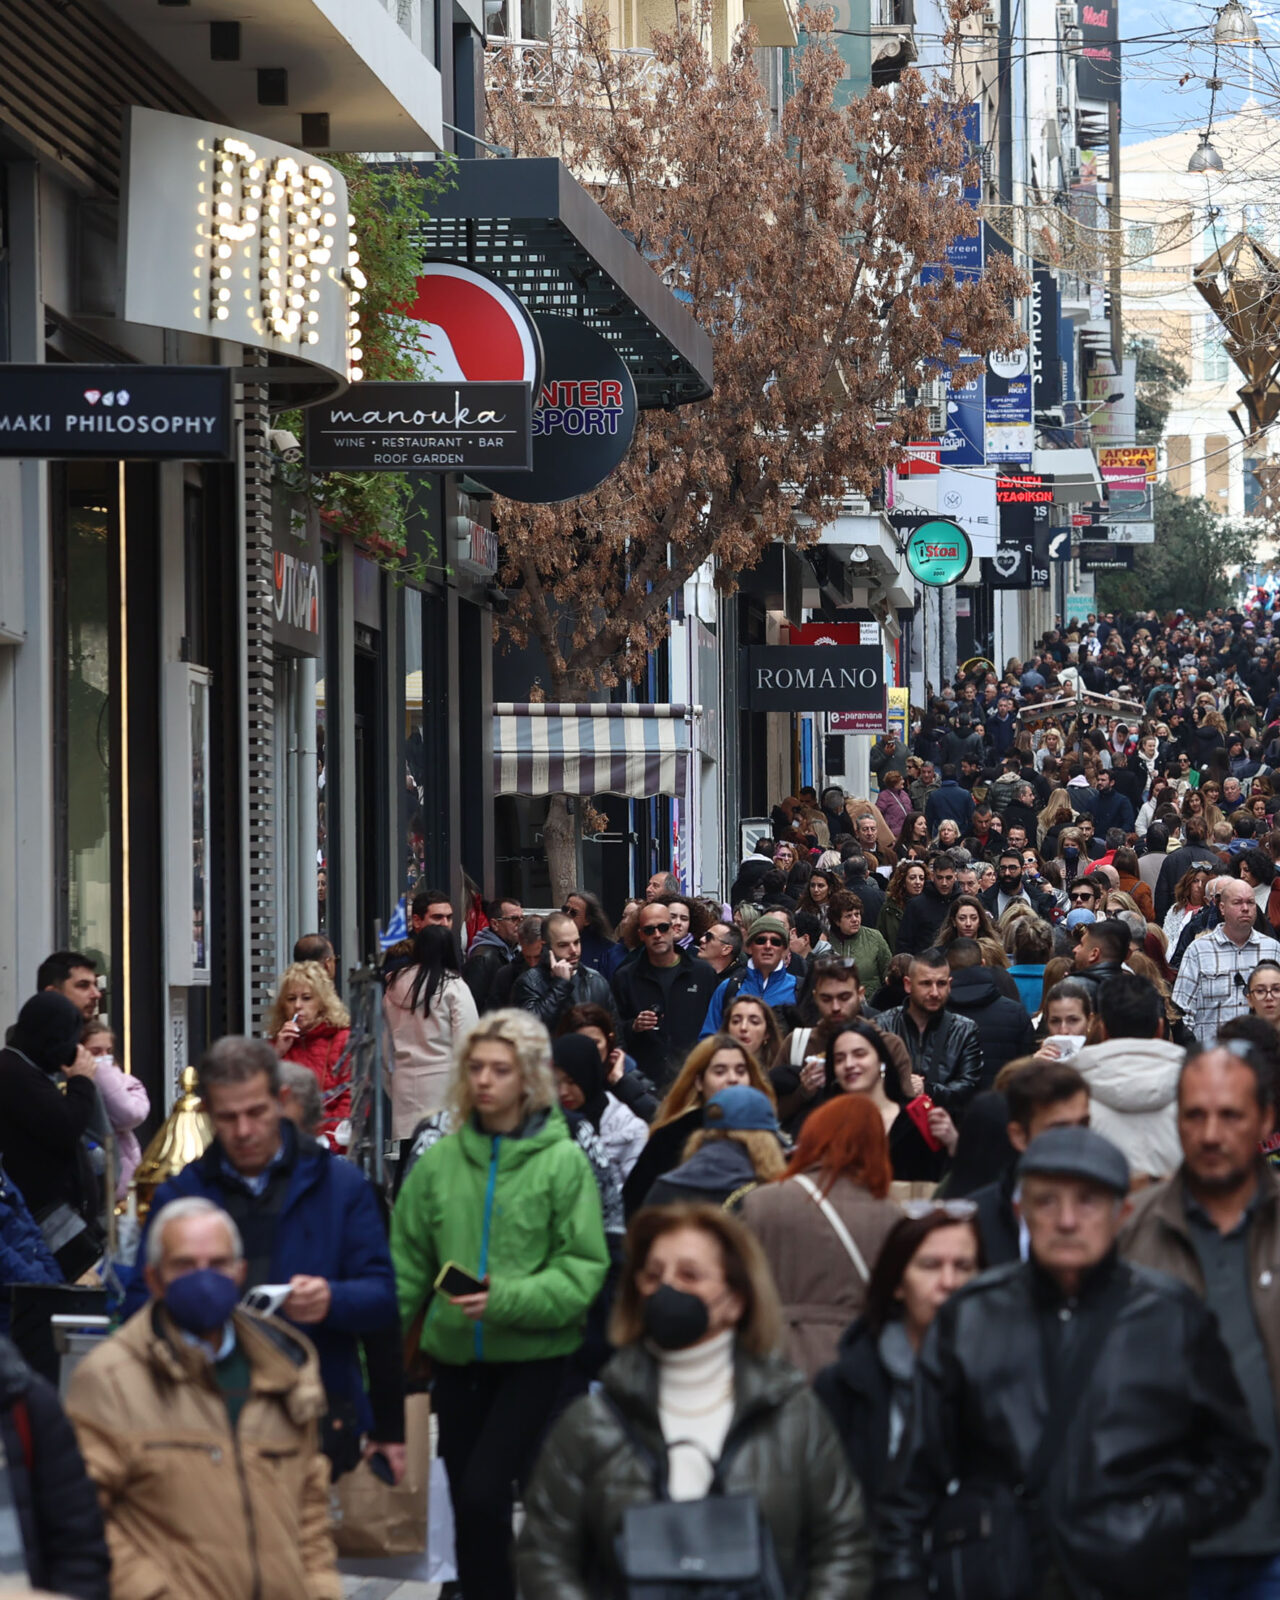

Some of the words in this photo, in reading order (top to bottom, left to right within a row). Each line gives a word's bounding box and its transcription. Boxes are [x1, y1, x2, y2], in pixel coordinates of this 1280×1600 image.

[329, 390, 508, 430] manouka
[65, 415, 216, 434] PHILOSOPHY
[334, 437, 366, 448] WINE
[381, 437, 462, 448] RESTAURANT
[478, 437, 504, 448] BAR
[373, 453, 409, 464] ROOF
[413, 453, 464, 464] GARDEN
[1105, 448, 1150, 458] ΑΓΟΡΑ
[756, 667, 877, 689] ROMANO
